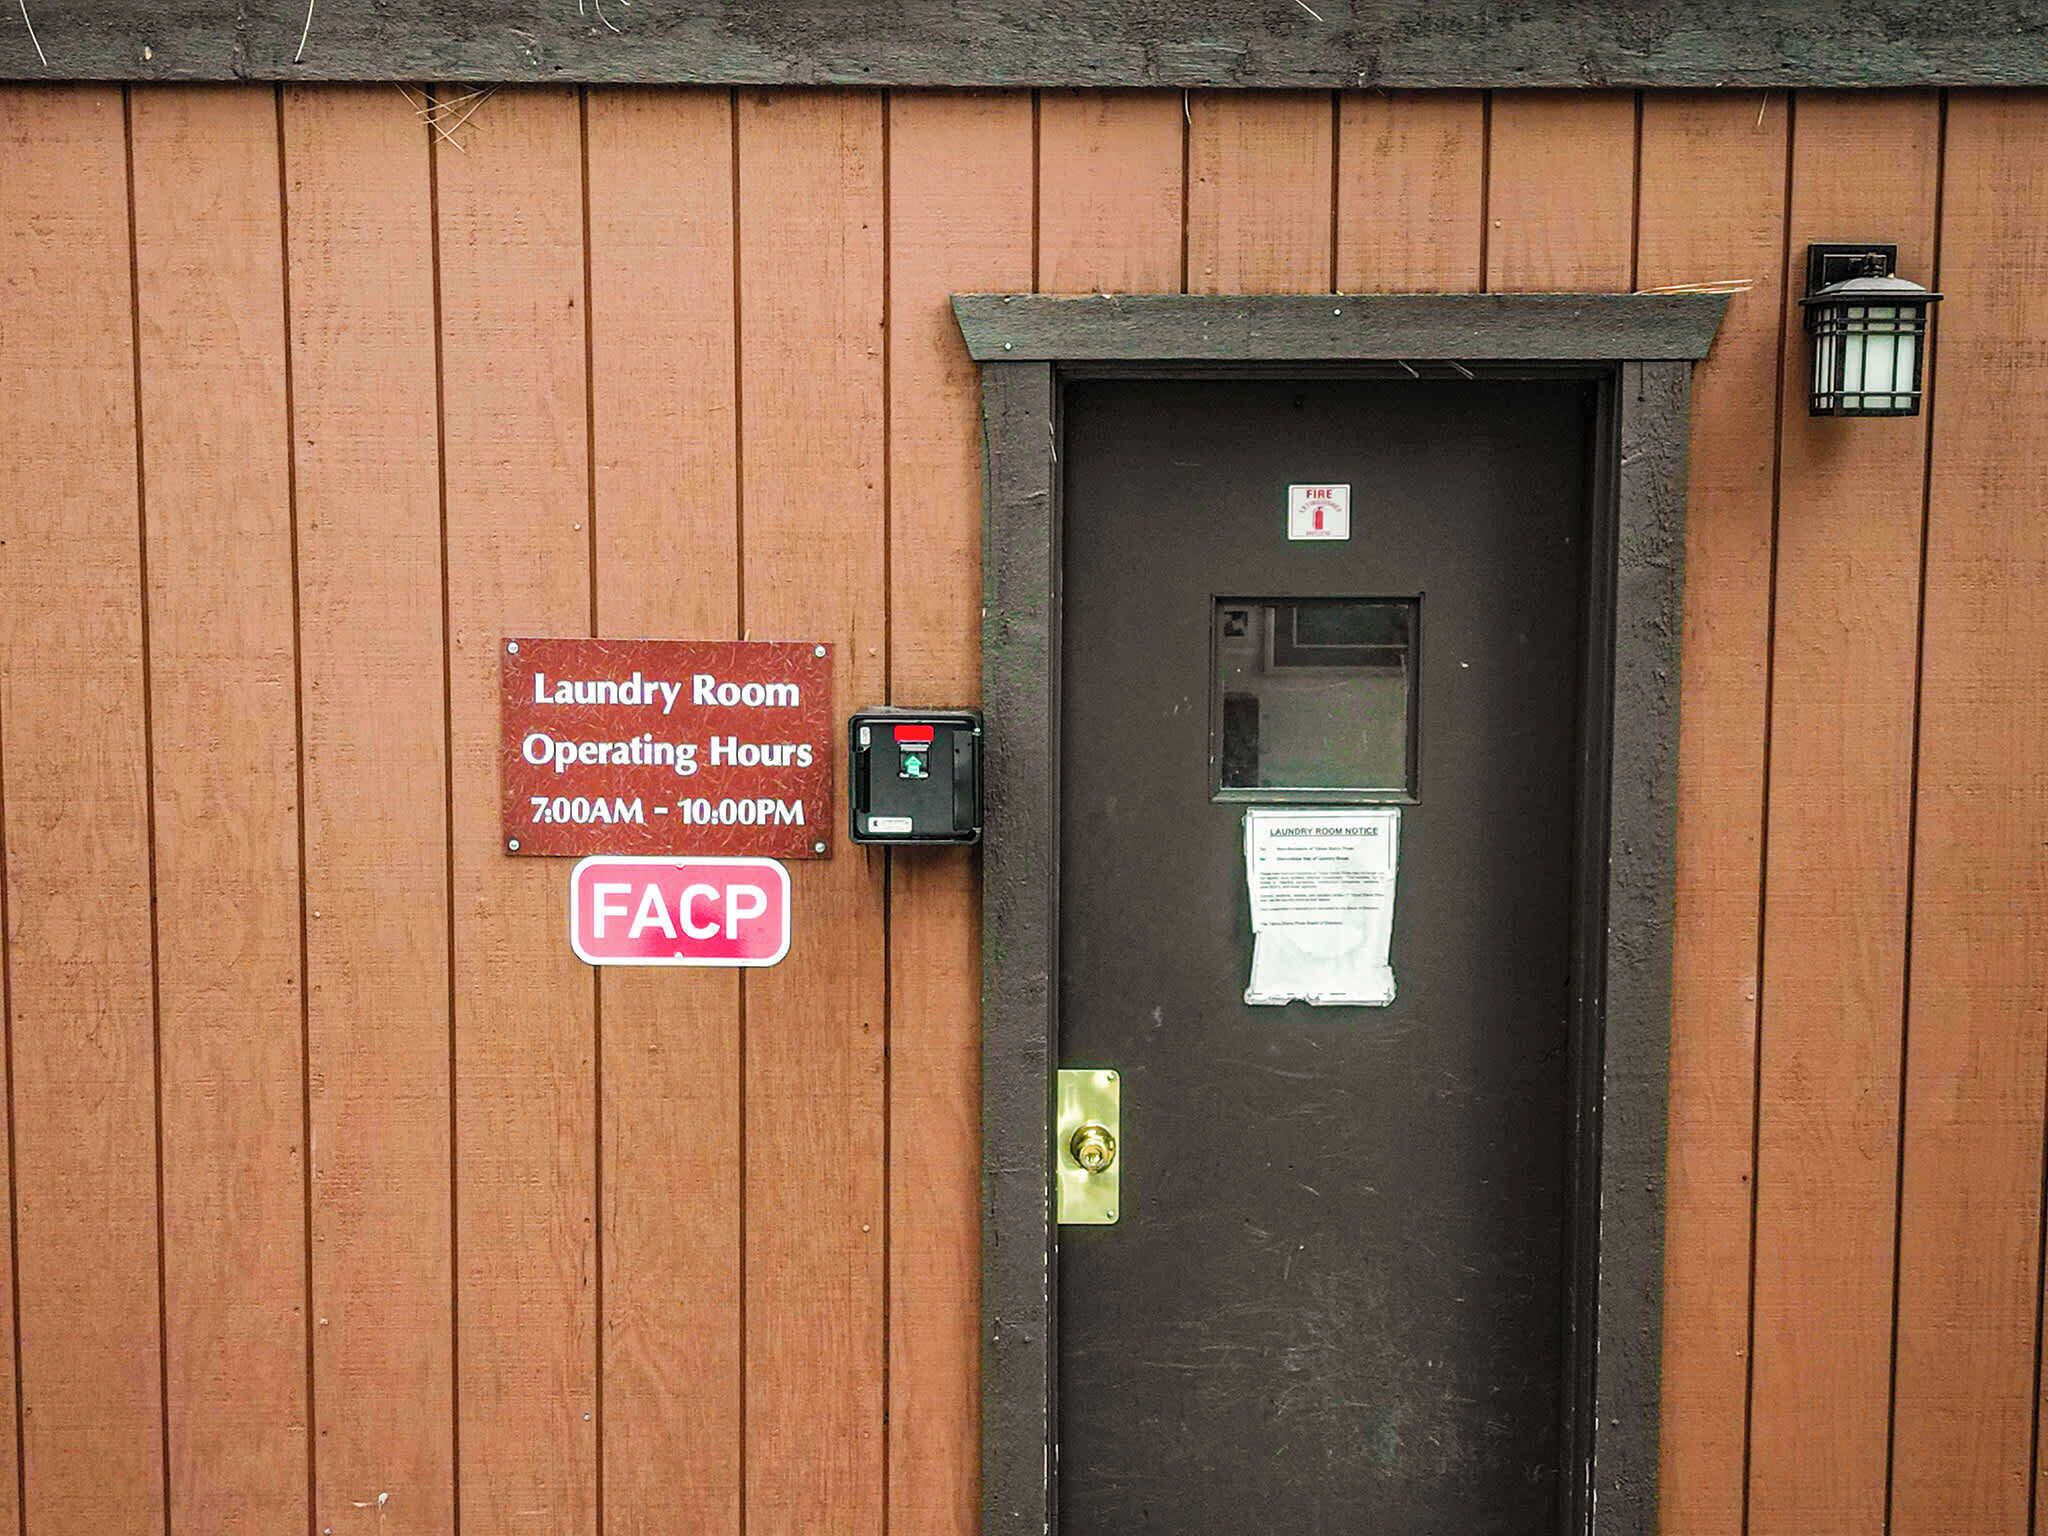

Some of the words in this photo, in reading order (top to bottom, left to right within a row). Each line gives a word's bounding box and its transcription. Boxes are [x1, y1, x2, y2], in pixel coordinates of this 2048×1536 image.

[1306, 488, 1333, 499] FIRE
[533, 672, 682, 714] Laundry
[692, 674, 800, 707] Room
[522, 733, 698, 775] Operating
[710, 735, 813, 768] Hours
[530, 796, 645, 824] 7:00AM
[653, 807, 669, 815] -
[677, 798, 806, 826] 10:00PM
[1270, 828, 1313, 837] LAUNDRY
[1315, 827, 1343, 836] ROOM
[1345, 827, 1378, 836] NOTICE
[592, 883, 768, 940] FACP
